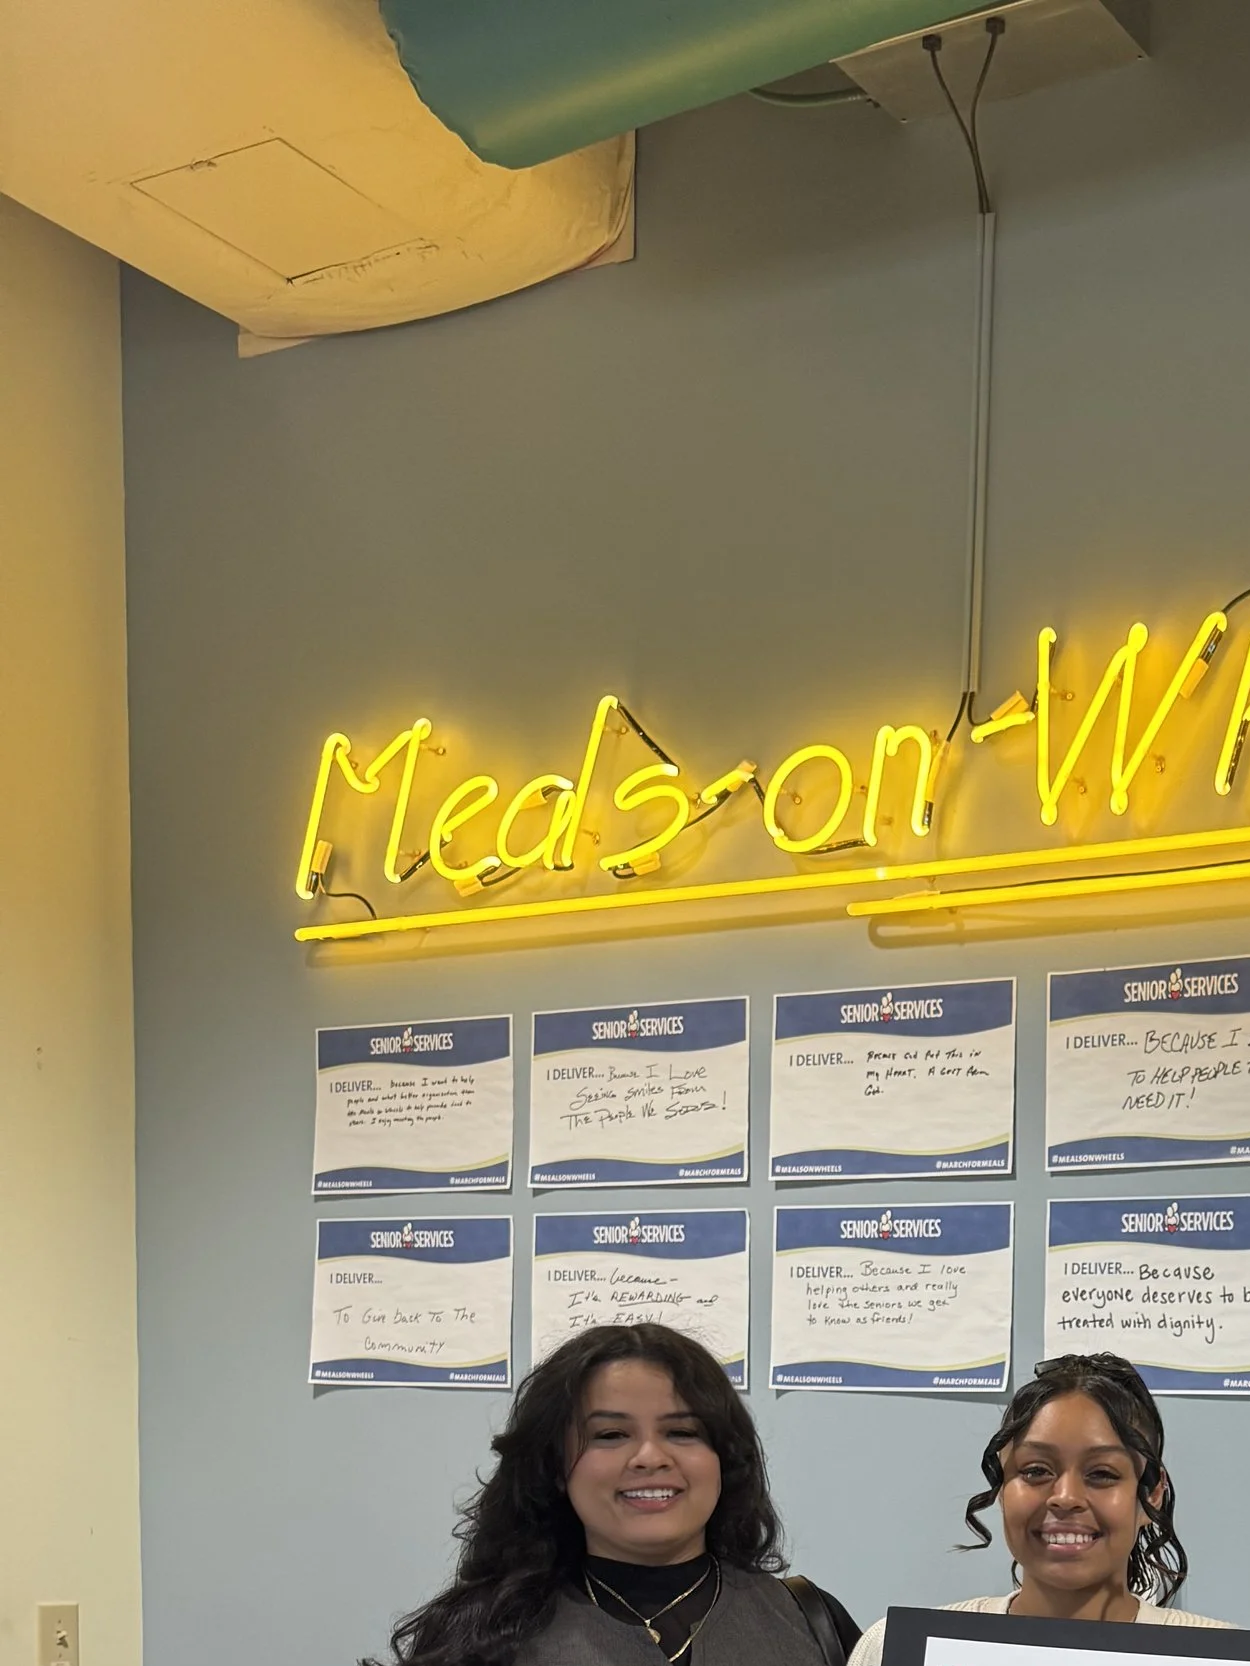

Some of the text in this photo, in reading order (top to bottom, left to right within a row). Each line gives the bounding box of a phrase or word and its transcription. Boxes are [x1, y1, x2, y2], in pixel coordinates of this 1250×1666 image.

[1124, 973, 1238, 1003] SENIOR SERVICES
[840, 999, 943, 1024] SENIOR SERVICES
[592, 1016, 683, 1040] SENIOR SERVICES
[370, 1033, 453, 1055] SENIOR SERVICES
[1066, 1034, 1138, 1049] I DELIVER...
[1144, 1030, 1217, 1054] BECAUSE
[1222, 1028, 1242, 1048] I
[790, 1053, 853, 1067] I DELIVER...
[547, 1067, 604, 1080] I DELIVER...
[1150, 1067, 1190, 1085] HELP
[330, 1081, 381, 1093] I DELIVER...
[1122, 1093, 1165, 1110] NEED
[1052, 1153, 1125, 1163] #MEALSONWHEELS
[840, 1219, 941, 1239] SENIOR SERVICES
[1121, 1211, 1234, 1232] SENIOR SERVICES
[371, 1231, 454, 1248] SENIOR SERVICES
[593, 1225, 685, 1244] SENIOR SERVICES
[548, 1270, 606, 1282] I DELIVER...
[790, 1266, 853, 1279] I DELIVER...
[860, 1261, 966, 1276] Because I love
[1064, 1262, 1134, 1275] I DELIVER...
[1139, 1264, 1215, 1280] Because
[330, 1273, 382, 1284] I DELIVER...
[806, 1281, 958, 1301] helping others and really
[1062, 1287, 1133, 1308] everyone
[1142, 1286, 1212, 1304] deserves
[1219, 1286, 1234, 1302] to
[808, 1300, 829, 1309] love
[807, 1314, 817, 1325] to
[1057, 1312, 1222, 1344] treated with dignity.
[776, 1374, 842, 1384] #MEALSONWHEELS
[933, 1377, 1000, 1386] #MARCHFORMEALS
